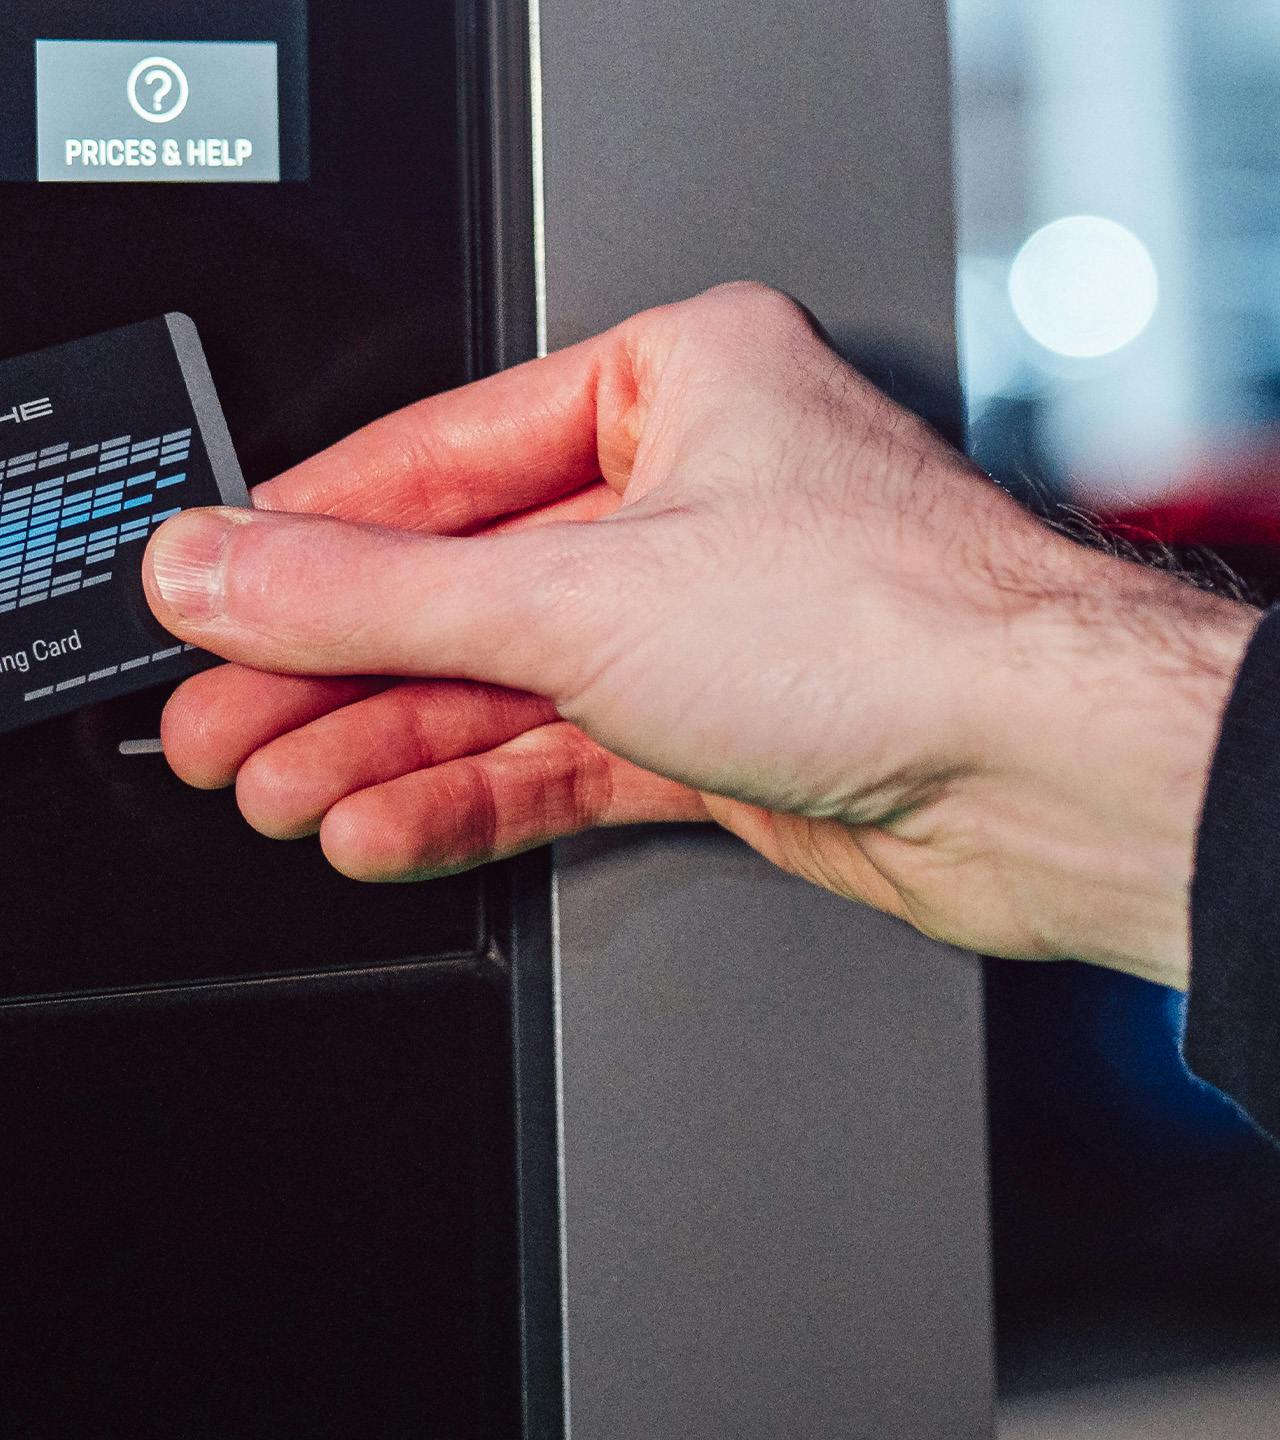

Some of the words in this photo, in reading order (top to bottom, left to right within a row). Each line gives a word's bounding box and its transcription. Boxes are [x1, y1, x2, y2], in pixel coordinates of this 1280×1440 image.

[64, 138, 157, 166] PRICES
[162, 139, 183, 166] &
[186, 139, 253, 166] HELP
[32, 629, 83, 664] Card
